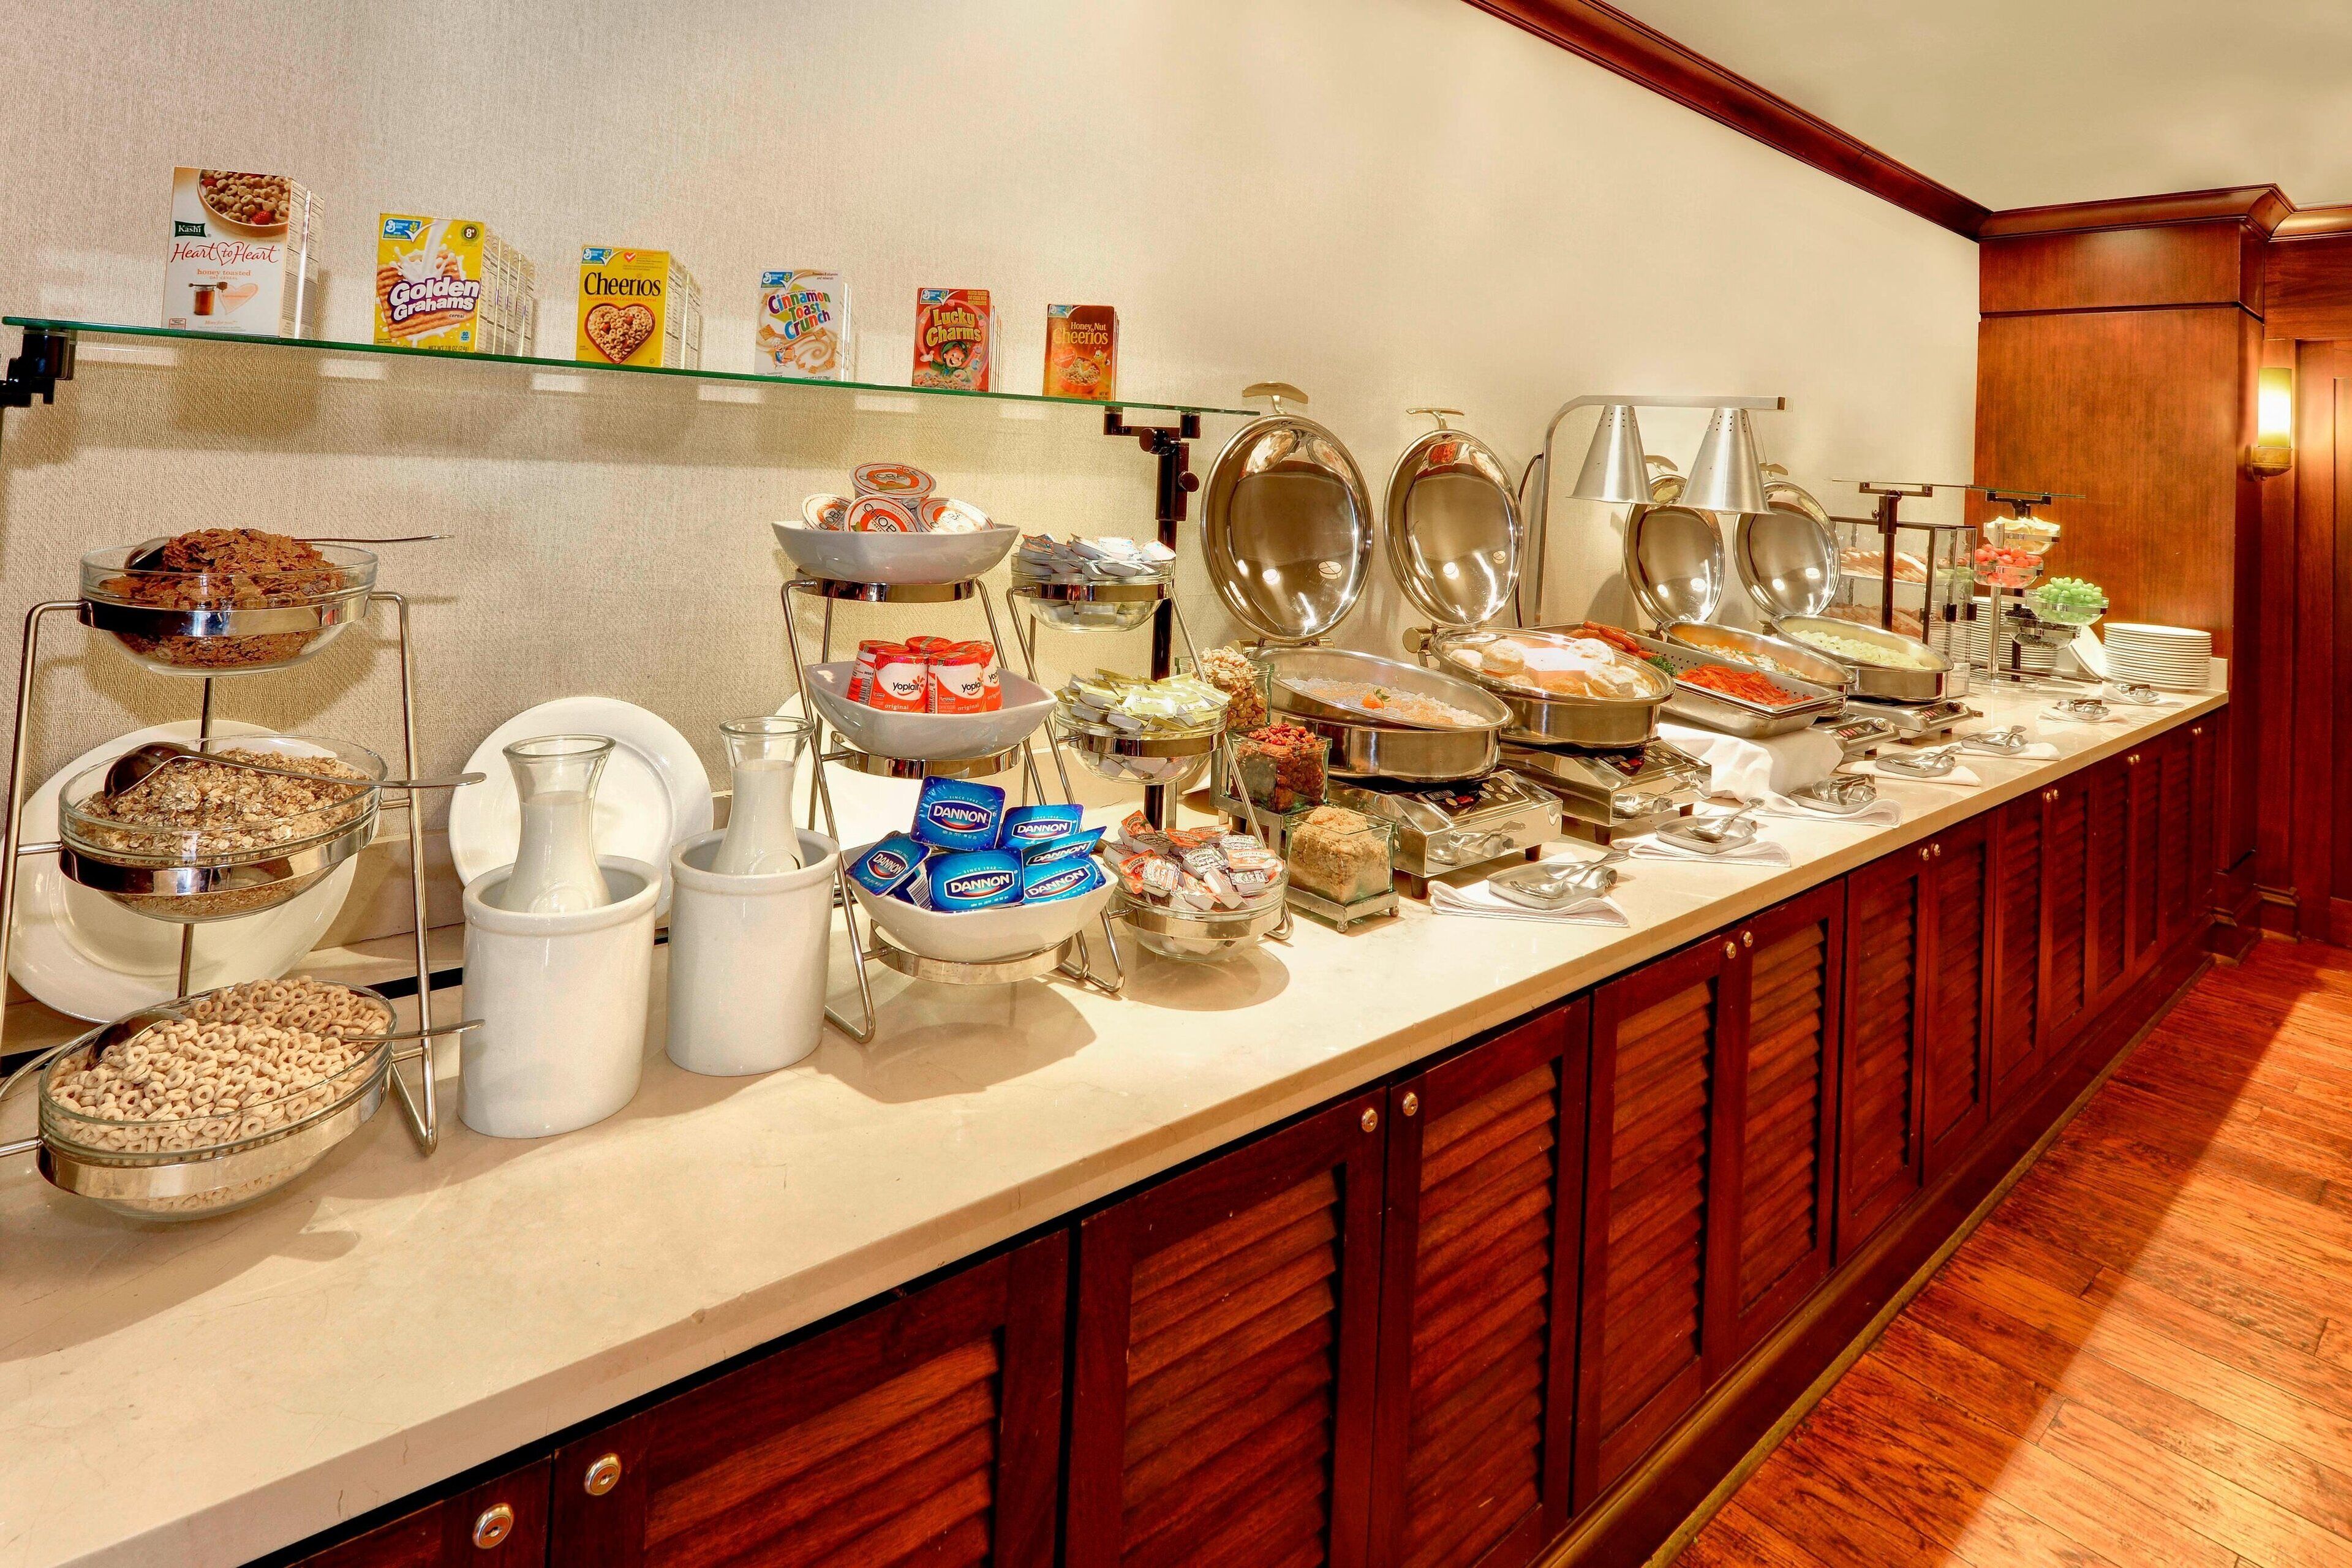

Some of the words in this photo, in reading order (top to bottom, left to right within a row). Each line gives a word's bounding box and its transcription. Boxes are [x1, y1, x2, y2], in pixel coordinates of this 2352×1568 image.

[171, 241, 217, 263] Heart
[221, 247, 233, 258] to
[232, 245, 279, 264] Heart
[390, 276, 480, 307] Golden
[584, 271, 661, 296] Cheerios
[393, 296, 474, 322] Grahams
[767, 291, 831, 315] Cinnamon
[788, 302, 821, 322] Toast
[784, 309, 831, 341] Crunch
[932, 307, 975, 327] Lucky
[1071, 322, 1091, 331] Honey
[1094, 322, 1106, 331] Nut
[926, 325, 982, 347] Charms
[1052, 326, 1109, 345] Cheerios
[862, 503, 897, 532] CHOB
[962, 681, 982, 693] Yopla
[957, 703, 979, 711] original
[933, 805, 987, 823] DANNON
[1017, 822, 1068, 833] DANNON
[1033, 843, 1088, 862] DANNON
[873, 853, 904, 875] DANNON
[951, 874, 1009, 893] DANNON
[1027, 870, 1085, 895] DANNON
